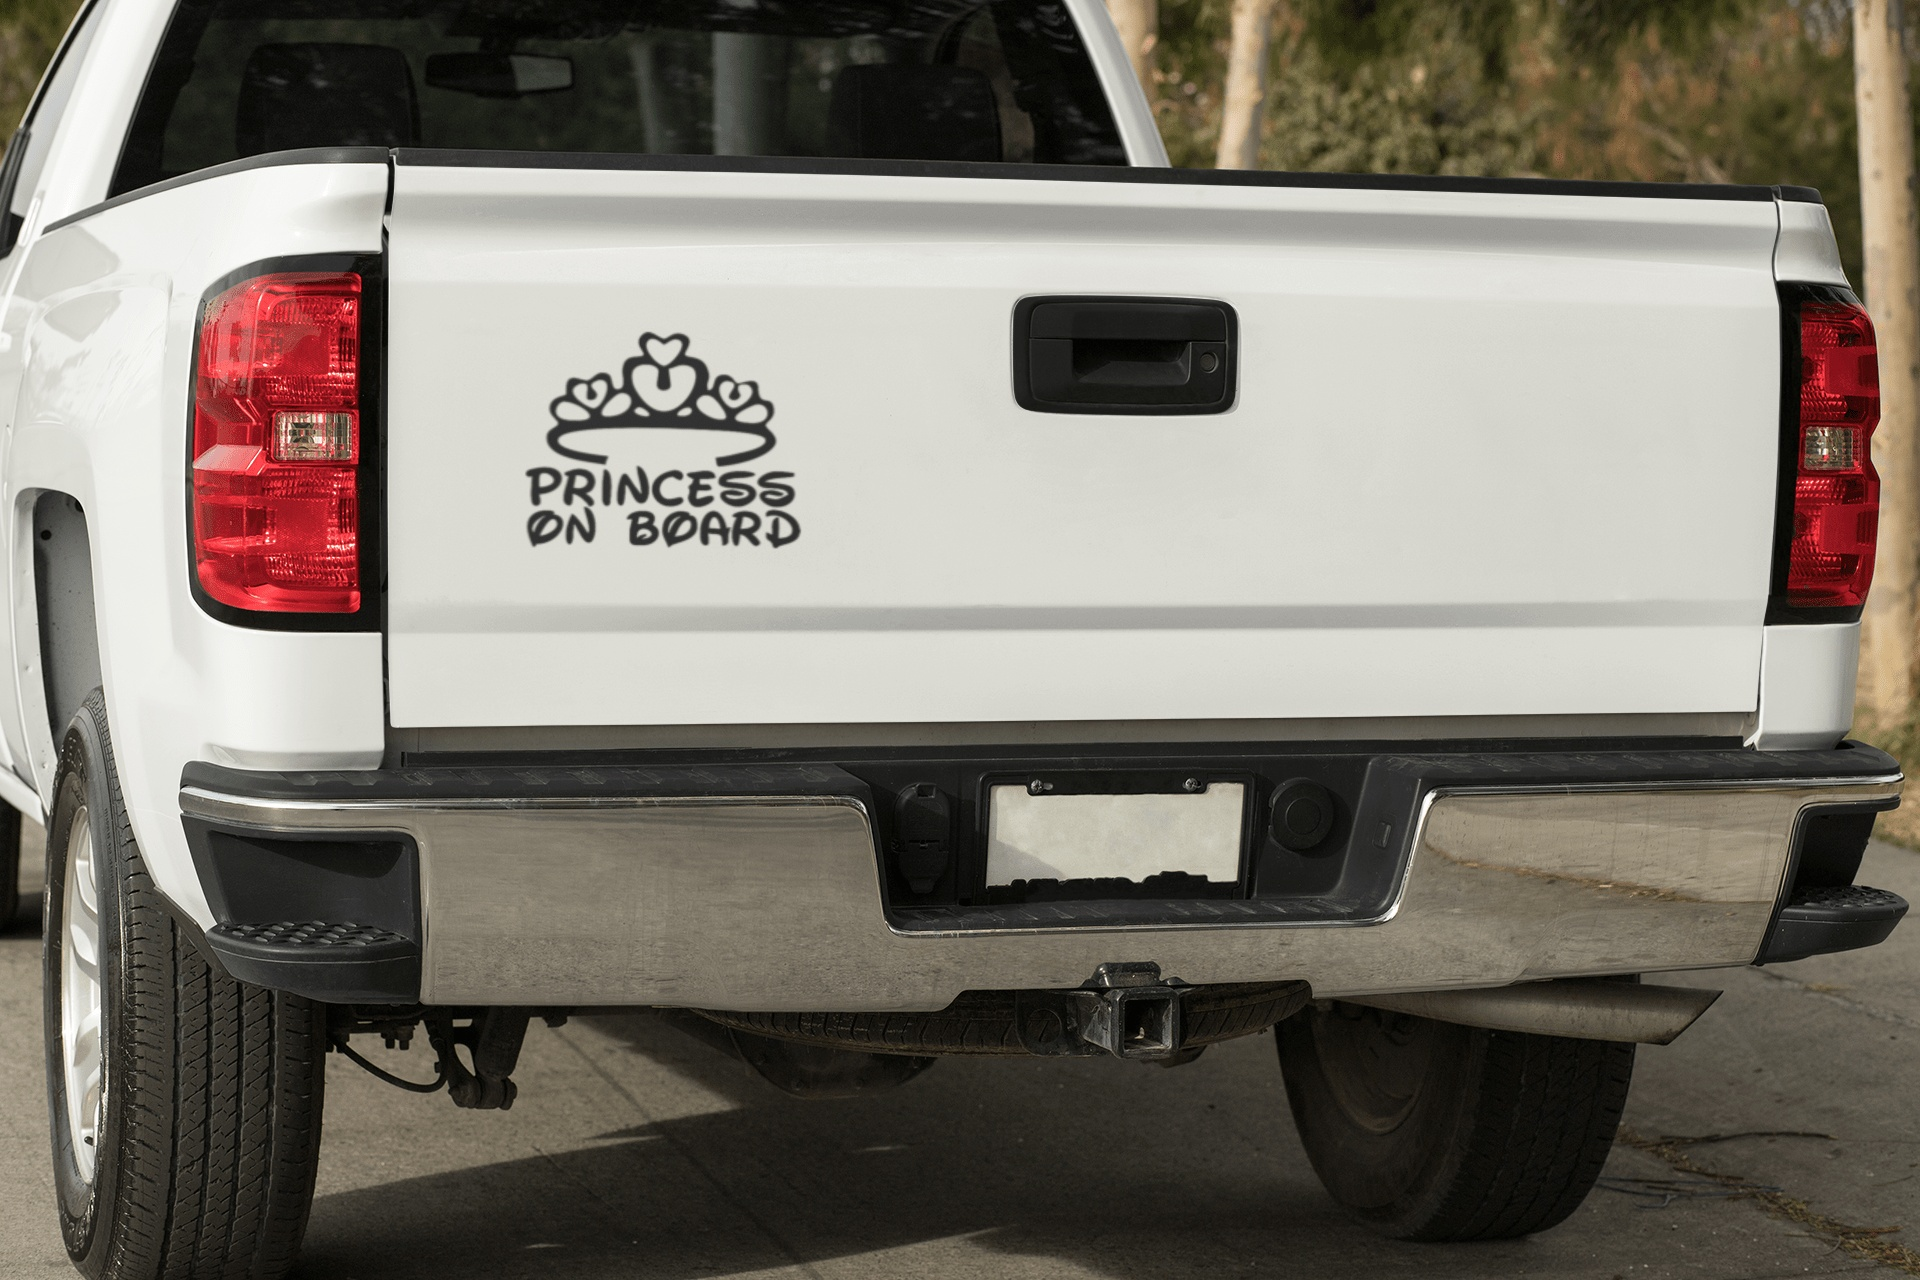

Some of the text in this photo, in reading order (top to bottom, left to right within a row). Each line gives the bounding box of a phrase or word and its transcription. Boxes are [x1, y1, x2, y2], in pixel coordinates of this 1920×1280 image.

[525, 466, 796, 507] PRINCESS
[527, 508, 801, 548] ON BOARD
